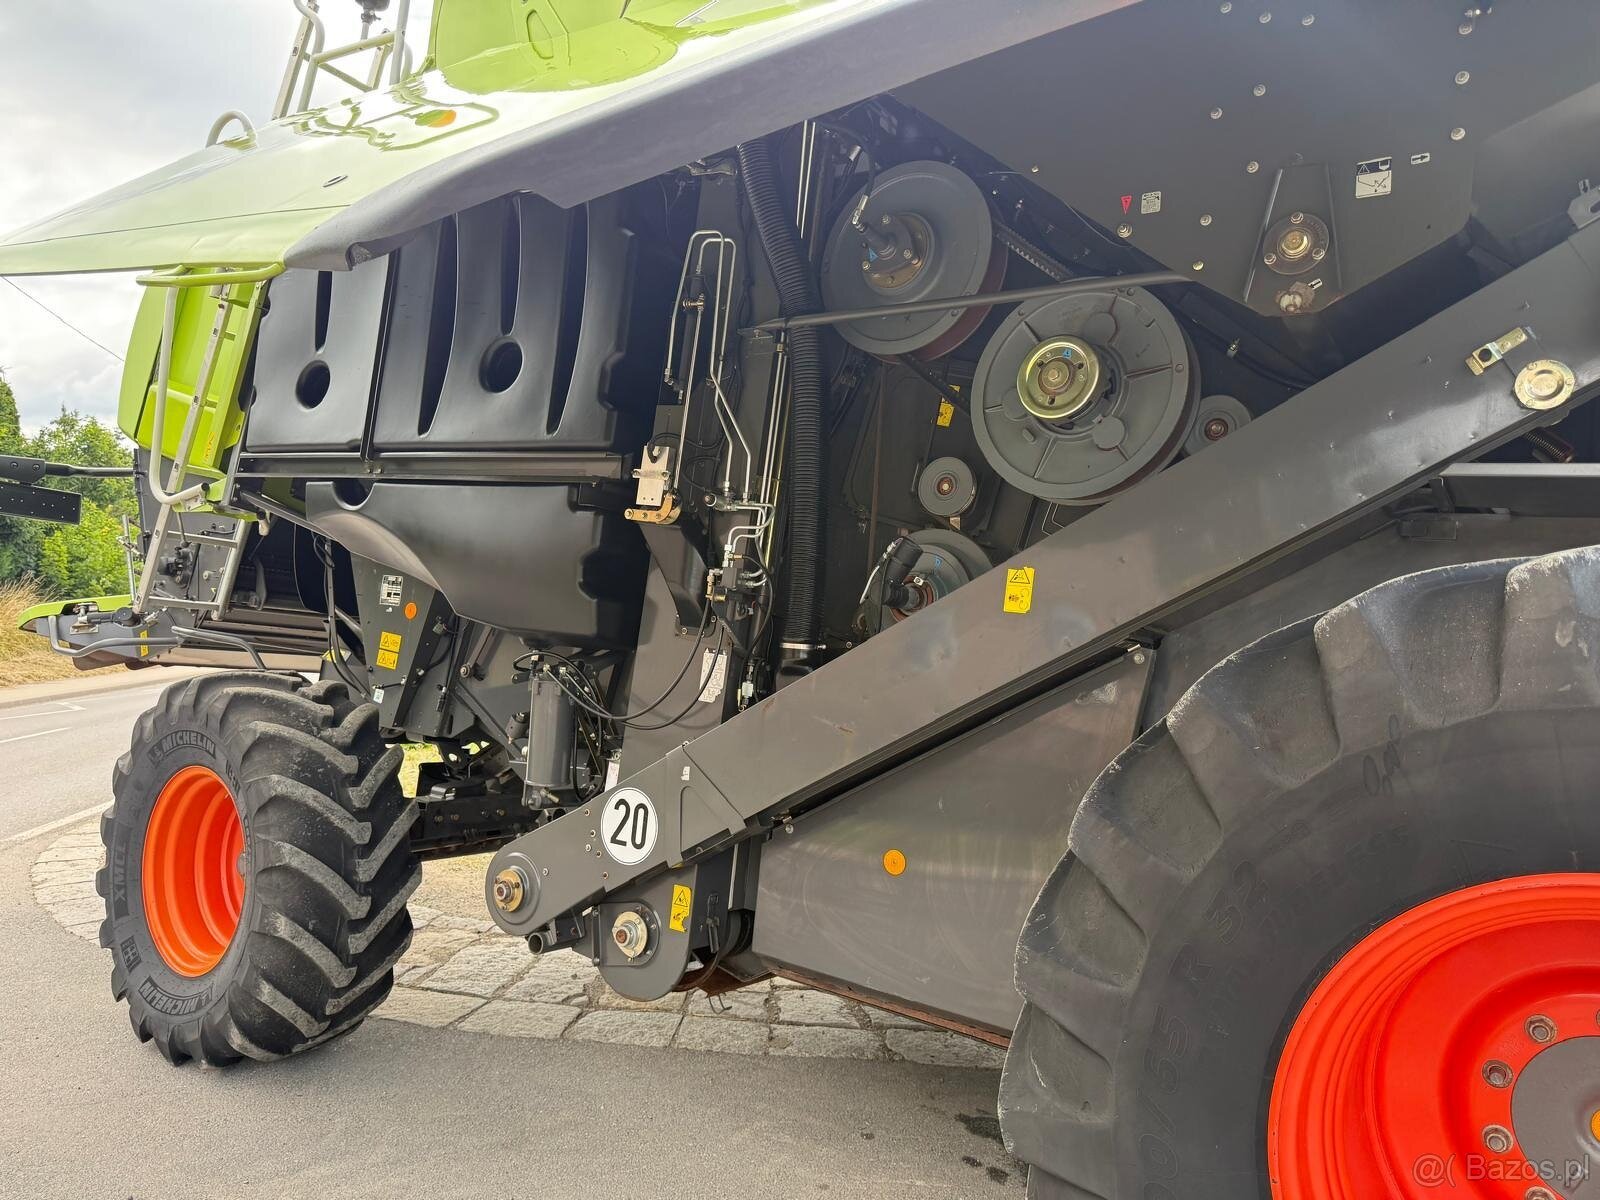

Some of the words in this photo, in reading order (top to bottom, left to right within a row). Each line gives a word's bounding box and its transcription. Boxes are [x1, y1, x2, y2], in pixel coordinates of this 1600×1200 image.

[161, 730, 216, 756] MICHELIN
[610, 798, 649, 850] 20
[1168, 942, 1216, 998] R
[1205, 860, 1269, 945] 32
[140, 980, 201, 1015] MICHELIN
